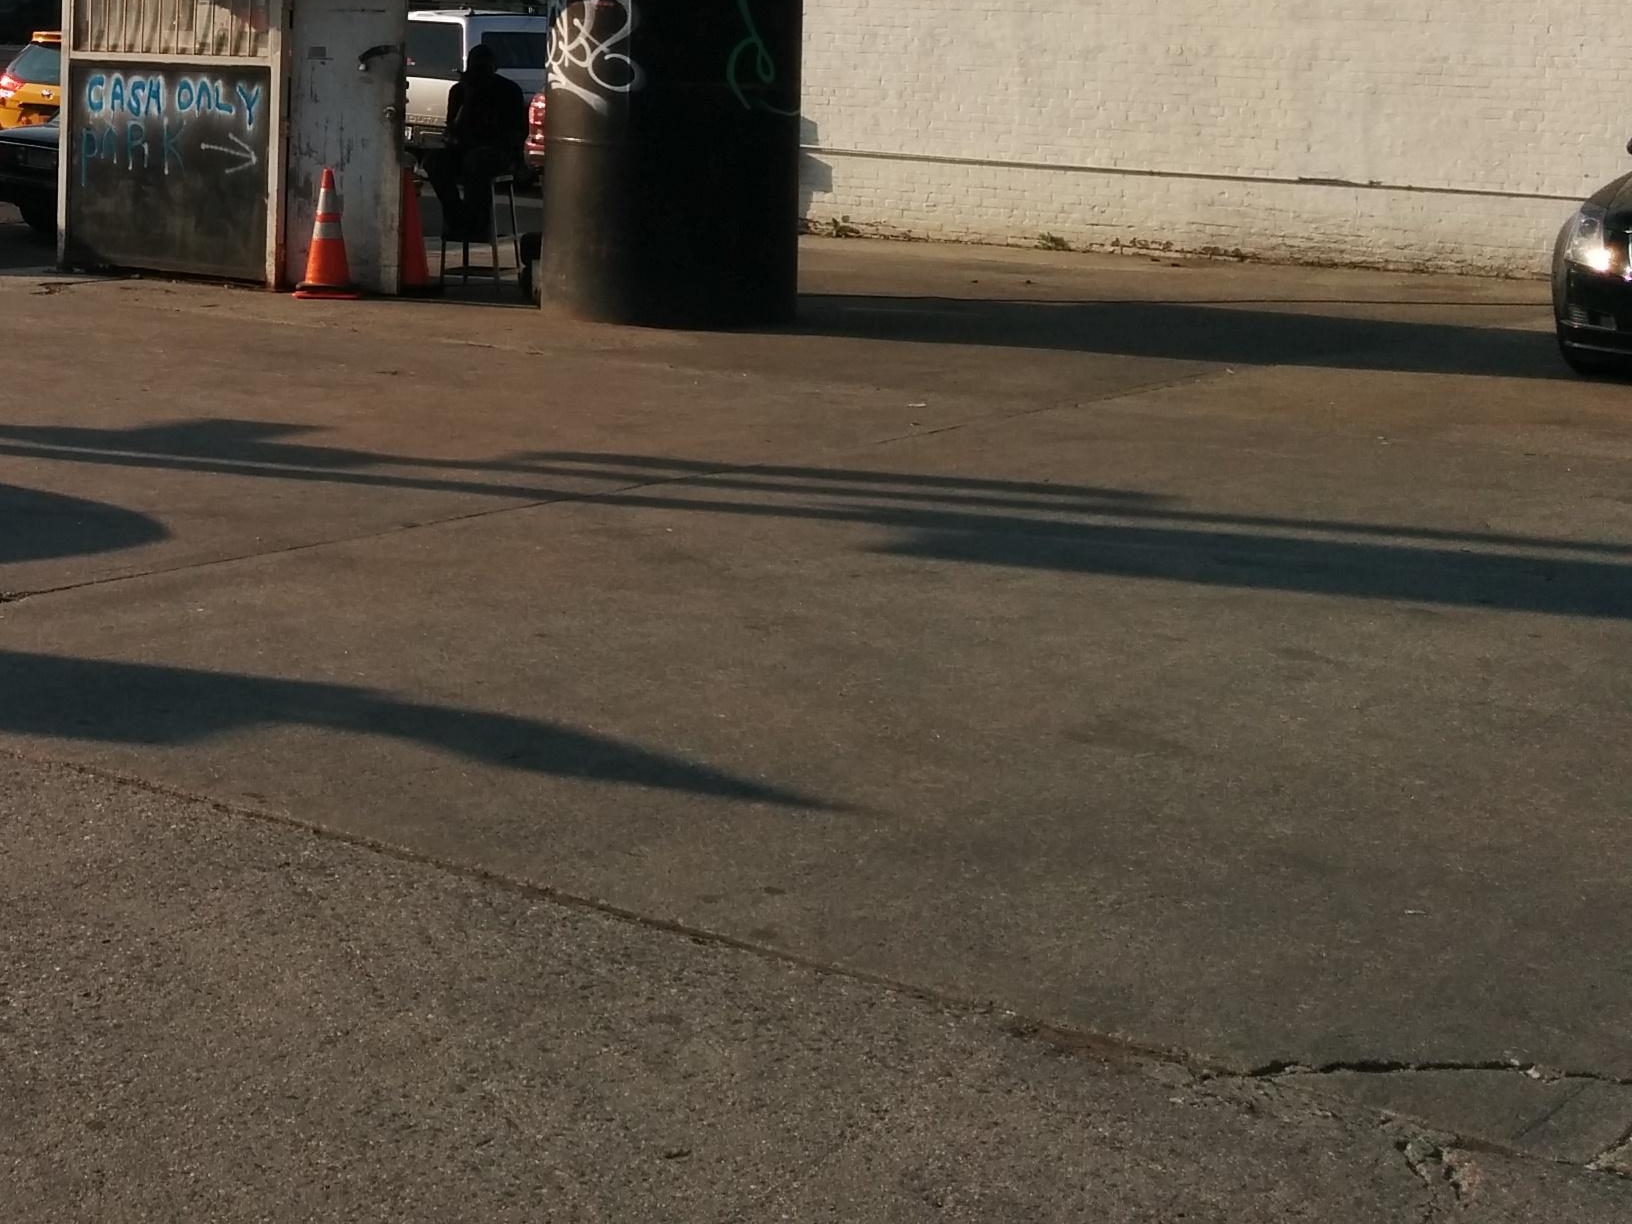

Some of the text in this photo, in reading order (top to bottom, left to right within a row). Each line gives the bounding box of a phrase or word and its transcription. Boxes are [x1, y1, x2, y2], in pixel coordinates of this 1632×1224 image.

[85, 73, 262, 132] CASH ONLY
[80, 118, 185, 187] PARK
